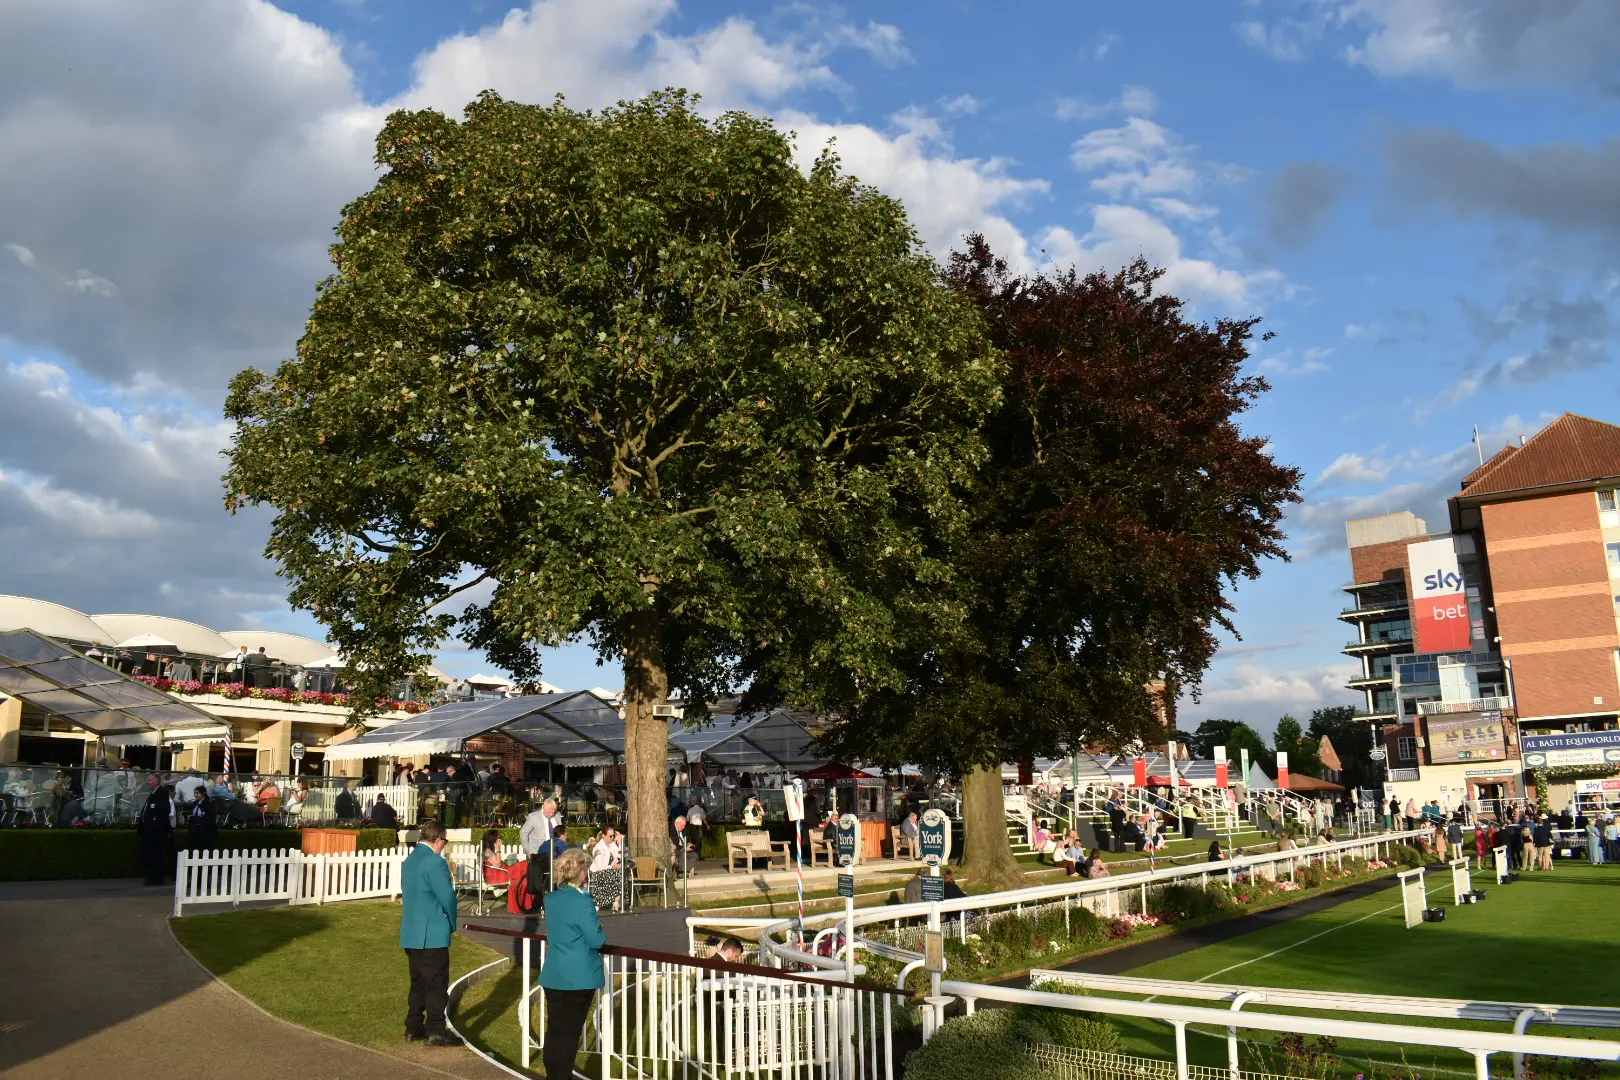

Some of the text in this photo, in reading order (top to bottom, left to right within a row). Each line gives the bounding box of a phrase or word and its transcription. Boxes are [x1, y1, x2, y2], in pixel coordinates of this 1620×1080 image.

[1424, 568, 1464, 592] sky
[1433, 604, 1466, 620] bet
[1539, 739, 1563, 747] BASTI
[1565, 735, 1620, 746] EQUIWORLD
[1603, 781, 1619, 789] bet
[838, 833, 854, 846] York
[921, 830, 943, 845] York
